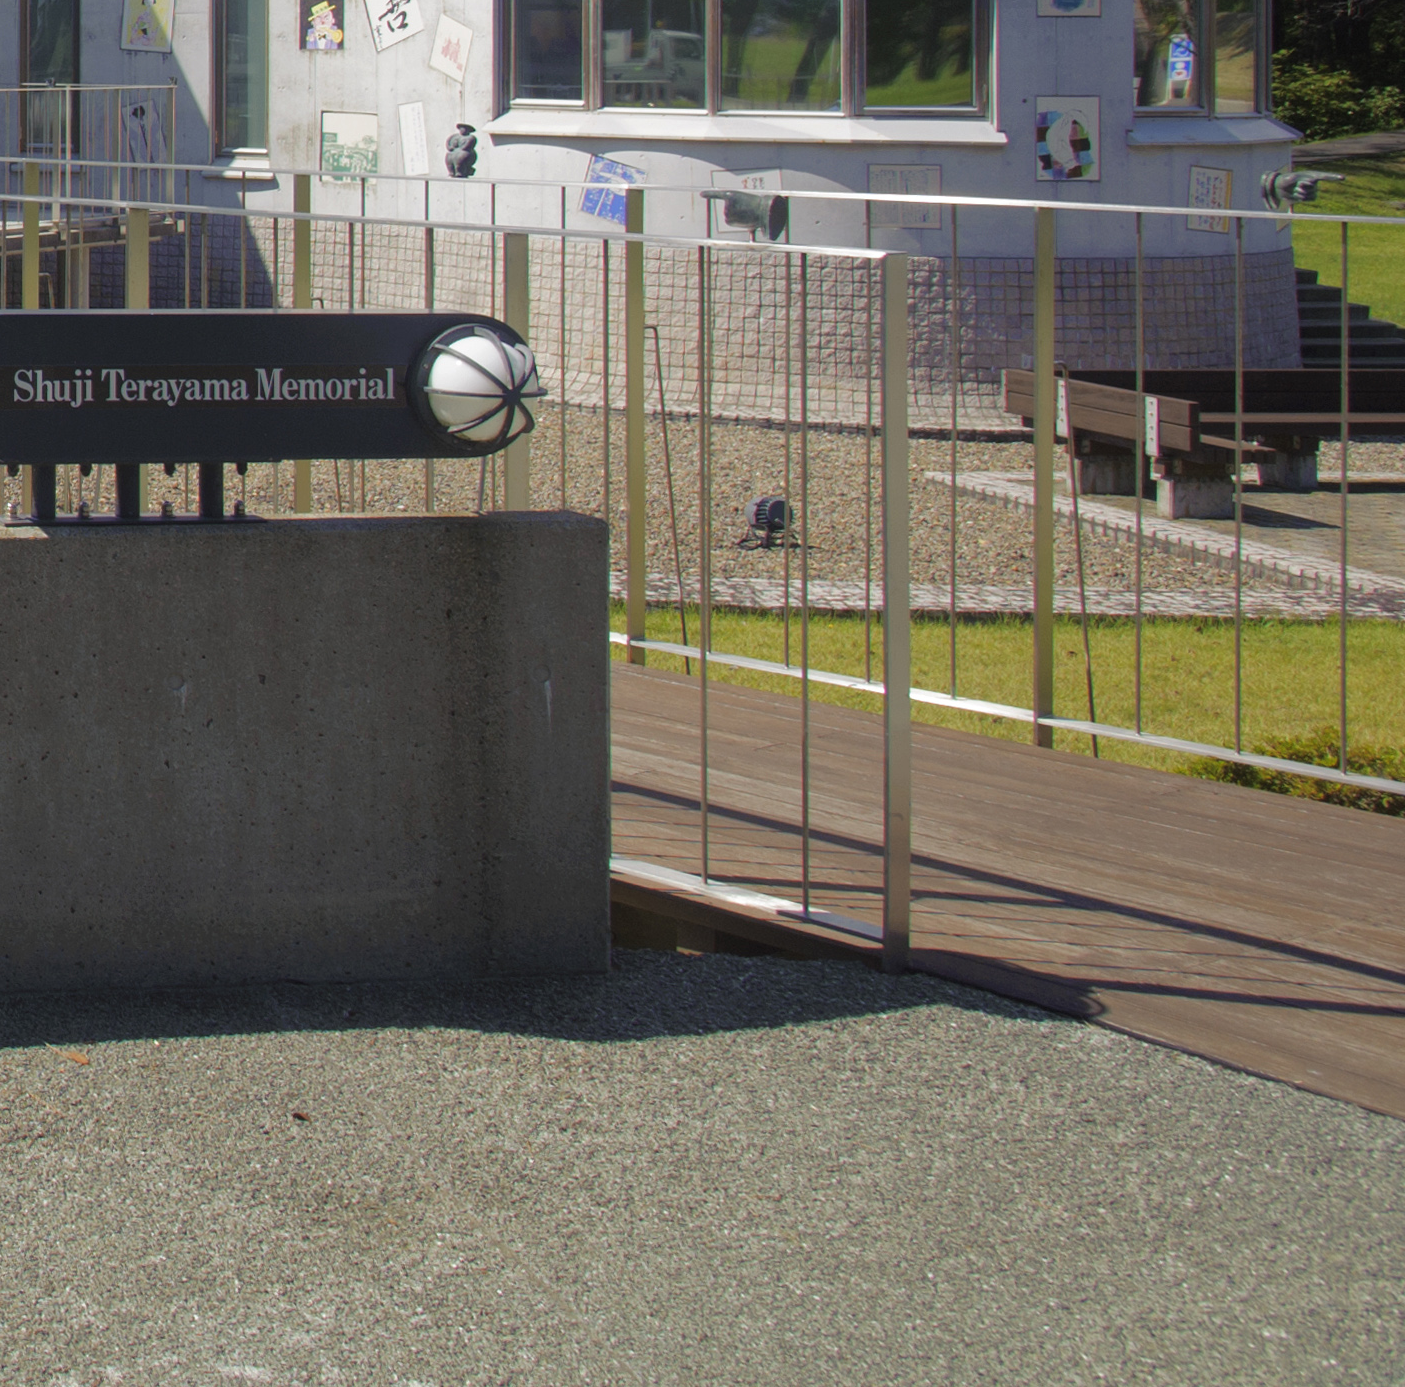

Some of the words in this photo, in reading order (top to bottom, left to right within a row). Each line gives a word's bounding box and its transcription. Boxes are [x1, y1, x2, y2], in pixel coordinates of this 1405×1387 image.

[13, 368, 94, 408] Shuji
[100, 368, 249, 407] Terayama
[254, 367, 396, 401] Memorial
